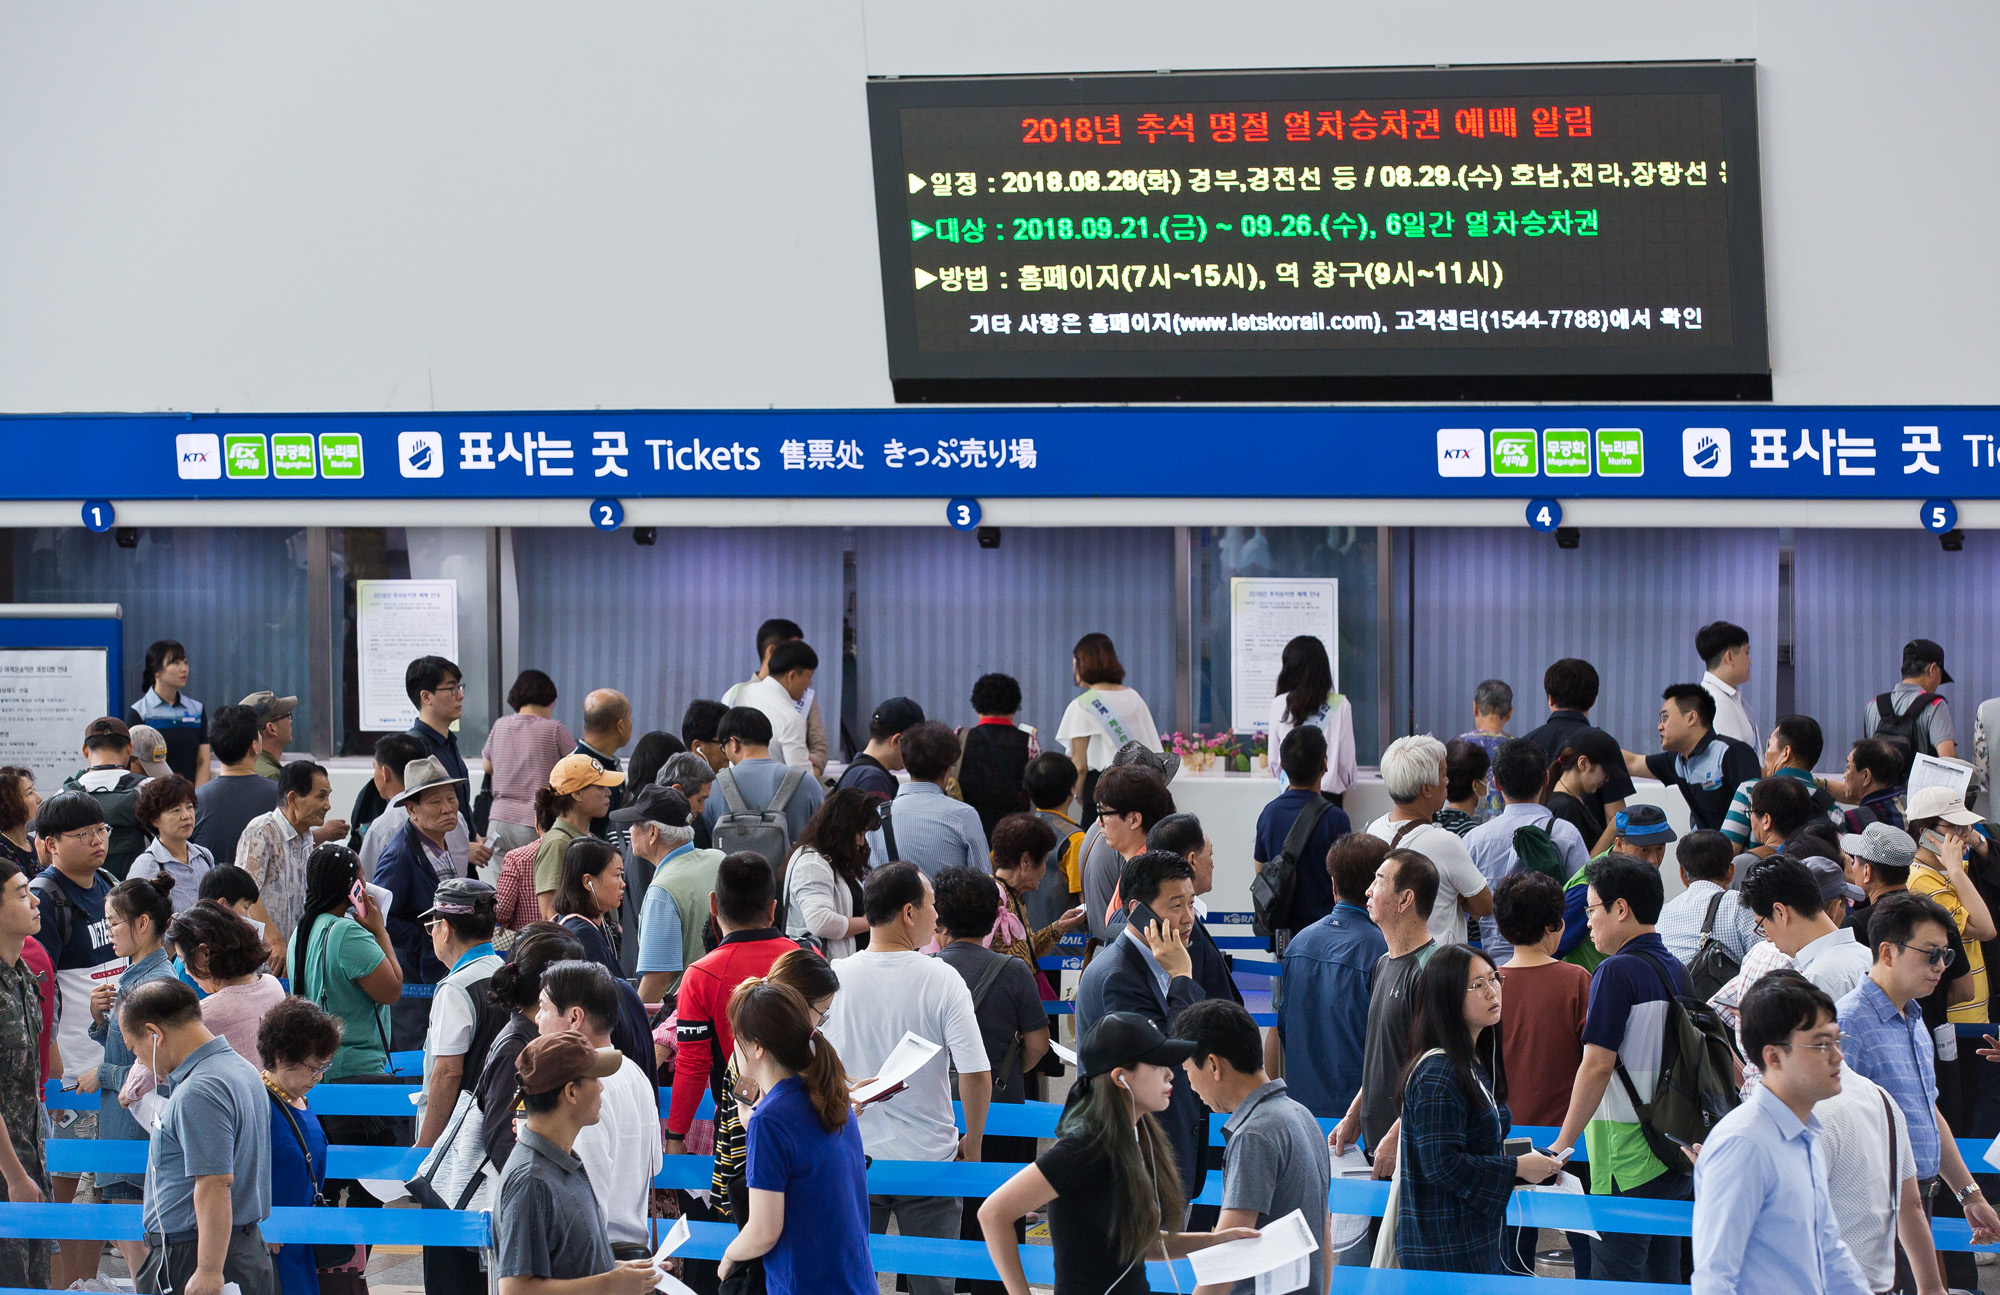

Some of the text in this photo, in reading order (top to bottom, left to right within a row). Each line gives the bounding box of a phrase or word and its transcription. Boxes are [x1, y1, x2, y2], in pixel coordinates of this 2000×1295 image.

[1022, 106, 1592, 144] 2018년 추석 명절 열차승차권 예매 알림
[931, 172, 977, 196] 일정
[1001, 169, 1181, 196] 2018.08.28(화)
[1188, 167, 1320, 192] 경부,경전선
[1332, 166, 1357, 190] 등
[1380, 165, 1502, 191] 08.29.(수)
[1511, 161, 1706, 188] 호남,전라,장항선
[935, 217, 987, 243] 대상
[1013, 214, 1207, 243] 2018.09.21.(금)
[1241, 212, 1376, 241] 09.26.(수),
[1386, 211, 1455, 237] 6일간
[1466, 209, 1598, 237] 열차승차권
[939, 266, 988, 291] 방법
[1018, 263, 1266, 292] 홈페이지(7시~15시),
[1276, 262, 1299, 288] 역
[1312, 260, 1503, 290] 창구(9시~11시)
[970, 308, 1701, 335] 기타 사항은 홈페이지(www.letskorail.com), 고객센터(1544-7788)에서 확인
[275, 444, 311, 460] 무궁화
[323, 444, 358, 460] 누리로
[460, 432, 1037, 477] 표사는 곳 Tickets 售票处 きっぷ売り場
[1444, 448, 1472, 459] KTX
[1547, 440, 1586, 457] 무궁화
[1601, 440, 1639, 456] 누리로
[1750, 429, 1876, 475] 표사는
[1902, 426, 1941, 474] 곳
[183, 452, 209, 463] KTX
[235, 458, 260, 470] 새마을
[330, 460, 353, 468] Nuriro
[1501, 455, 1529, 467] 새마을
[1547, 457, 1587, 467] Mugunghwa
[1608, 457, 1632, 466] Nuriro
[92, 508, 101, 526] 1
[600, 506, 613, 525] 2
[958, 506, 970, 525] 3
[1537, 507, 1551, 526] 4
[1933, 508, 1945, 527] 5
